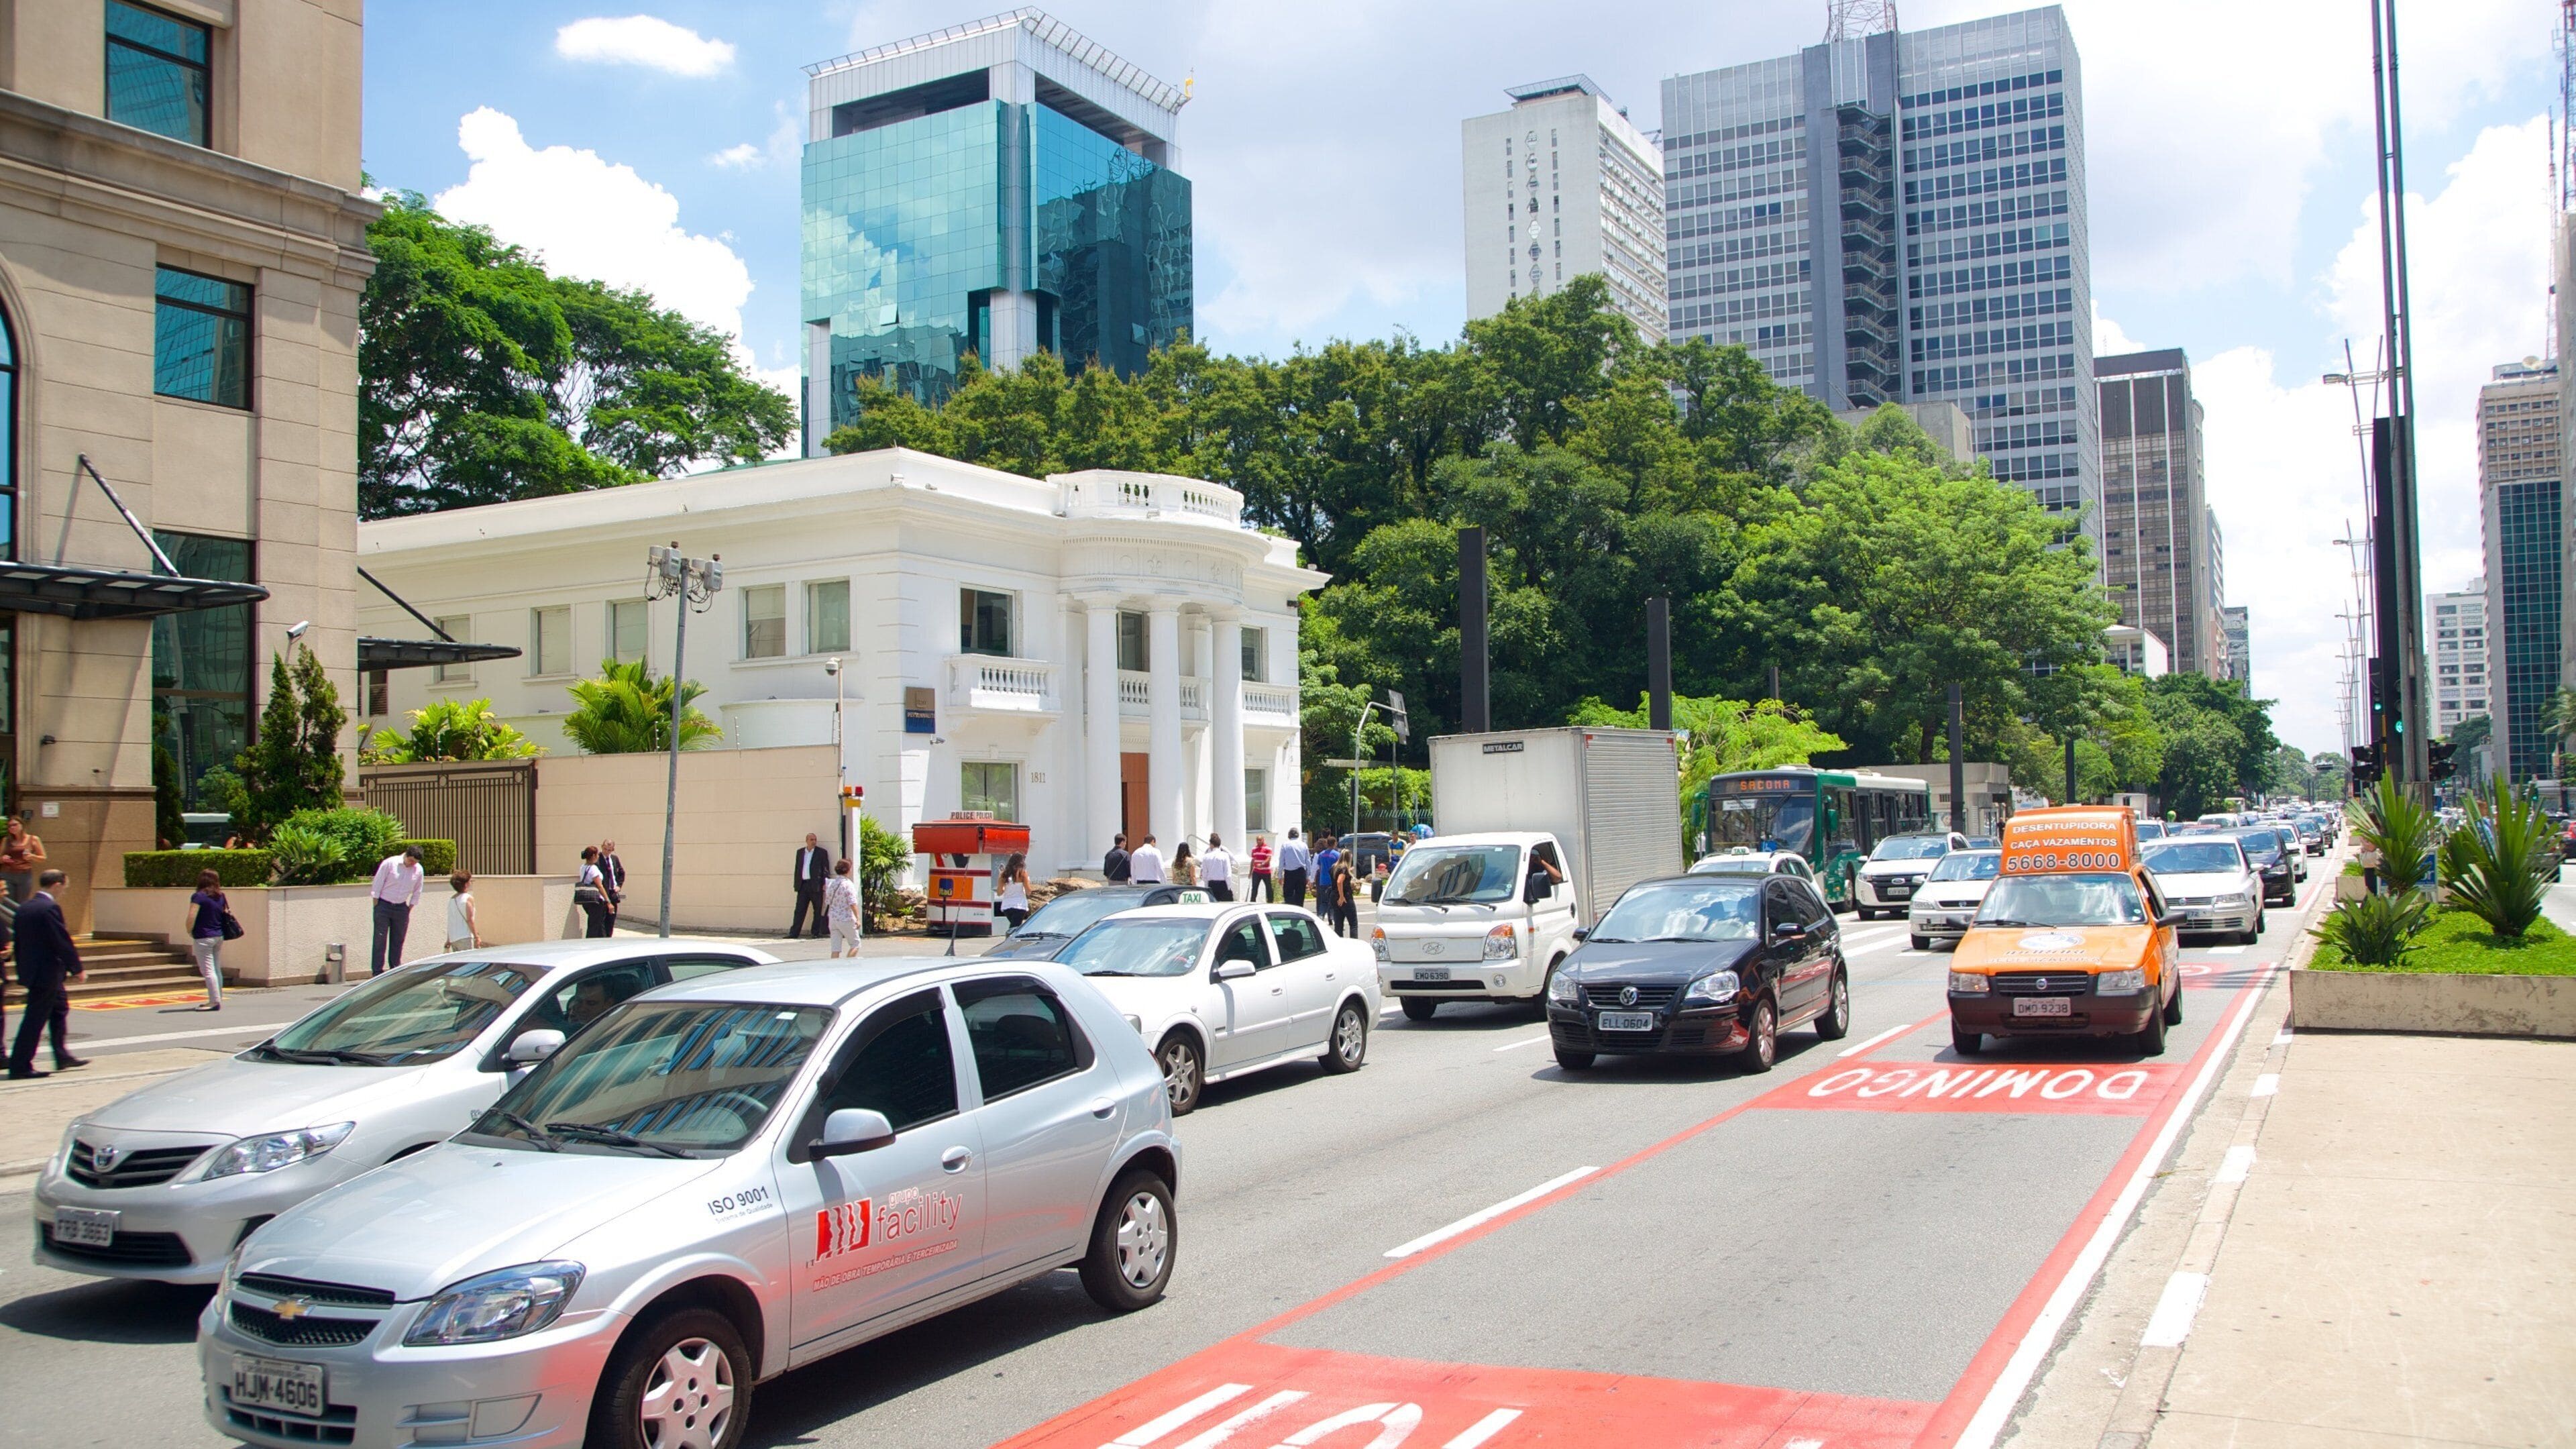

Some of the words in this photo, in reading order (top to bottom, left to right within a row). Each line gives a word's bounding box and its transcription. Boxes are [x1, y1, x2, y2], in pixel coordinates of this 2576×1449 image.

[1484, 743, 1522, 751] METALCAR
[1031, 772, 1046, 784] 1811
[951, 812, 973, 820] POLICE
[2013, 822, 2116, 834] DESENTUPIDORA
[2010, 840, 2040, 850] CAÇA
[2043, 838, 2117, 847] VAZAMENTOS
[2007, 853, 2120, 871] 5668-8000
[939, 888, 952, 896] Itaú
[1183, 893, 1201, 903] TAXI
[1808, 1069, 2147, 1099] DOMINGO
[708, 1197, 735, 1215] ISO
[737, 1185, 769, 1206] 9001
[889, 1187, 918, 1208] grupo
[876, 1191, 963, 1242] facility
[813, 1276, 830, 1292] MÃO
[830, 1273, 841, 1287] DE
[842, 1268, 861, 1283] OBRA
[862, 1255, 906, 1277] TEMPORÁRIA
[912, 1239, 958, 1260] TERCEIRIZADA
